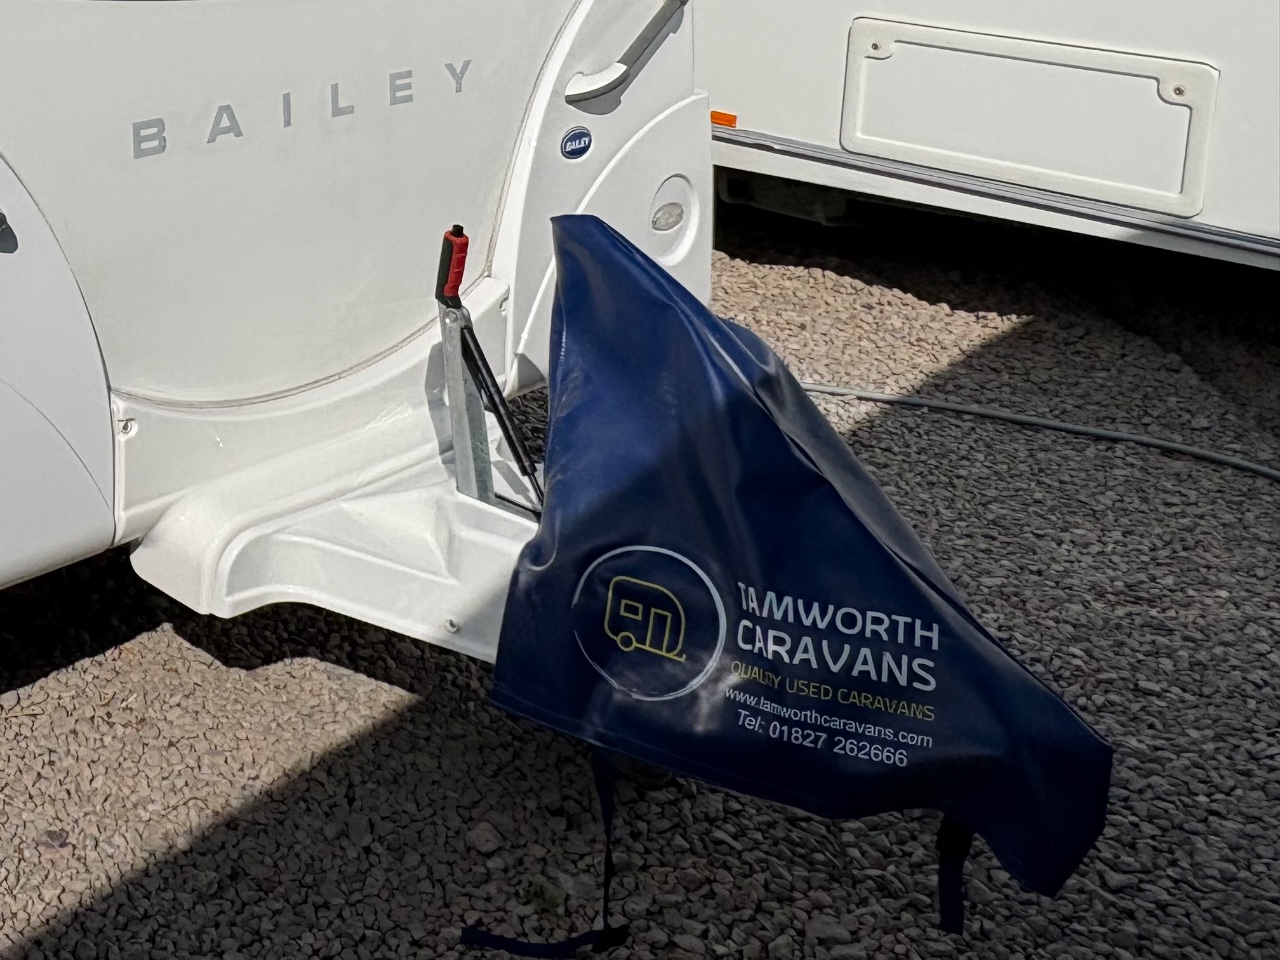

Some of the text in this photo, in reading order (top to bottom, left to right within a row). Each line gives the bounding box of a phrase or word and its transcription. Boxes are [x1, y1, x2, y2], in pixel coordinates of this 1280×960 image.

[132, 59, 472, 160] BAILEY
[737, 581, 940, 651] TAMWORTH
[737, 619, 937, 691] CARAVANS
[786, 677, 833, 701] USED
[837, 688, 935, 721] CARAVANS
[737, 709, 909, 767] Tel: 01827 262666
